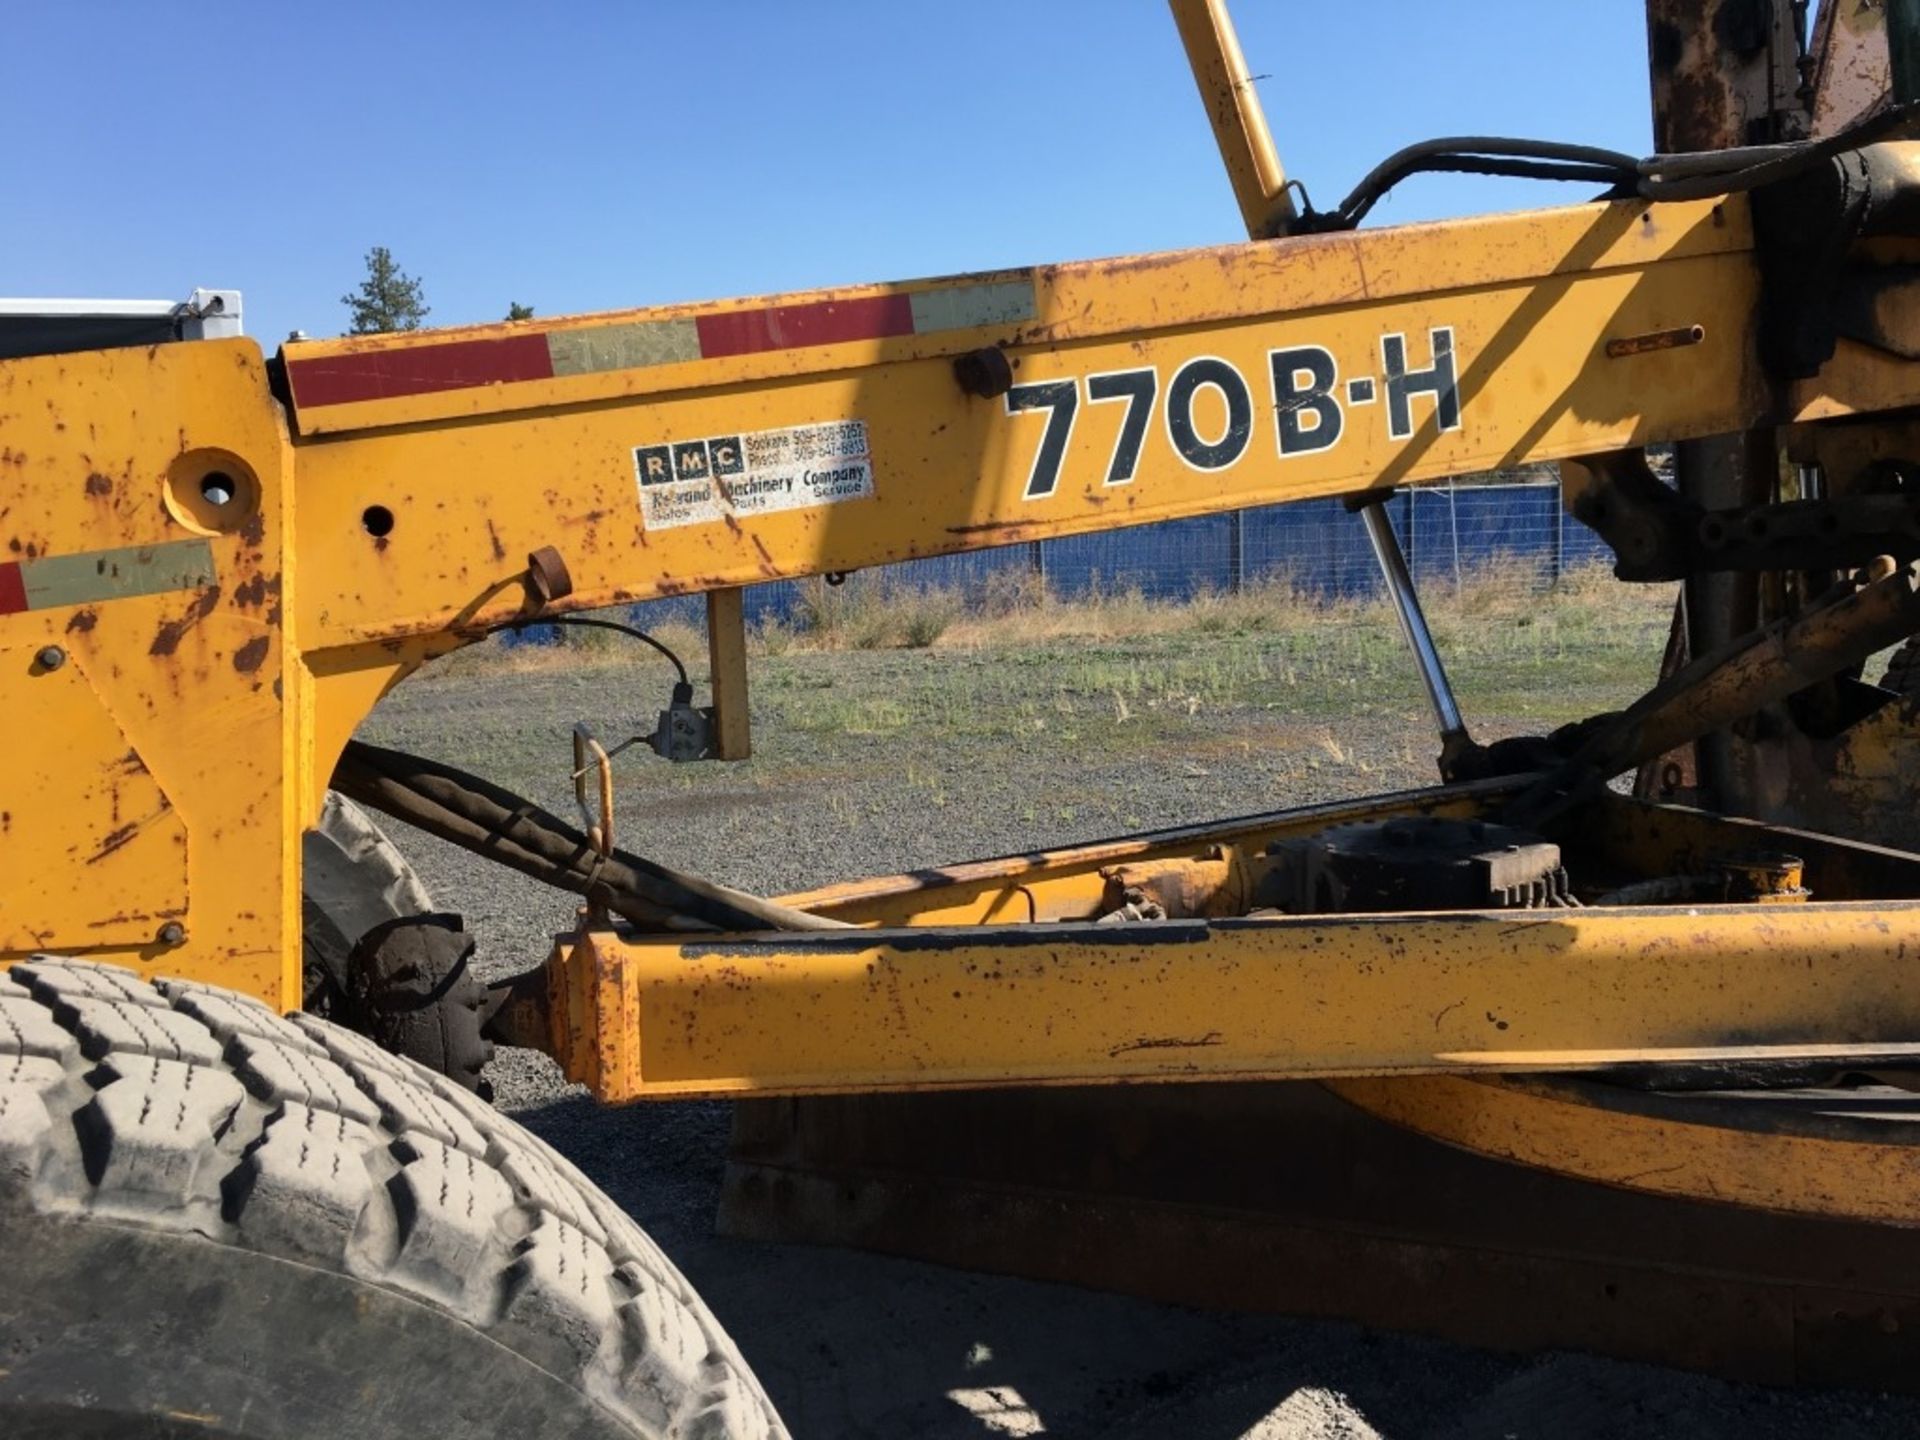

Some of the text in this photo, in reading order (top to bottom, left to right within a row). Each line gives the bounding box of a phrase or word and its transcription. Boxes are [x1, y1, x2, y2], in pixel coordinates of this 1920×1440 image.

[803, 463, 866, 486] Company
[731, 497, 766, 509] Parts
[813, 483, 863, 498] Service
